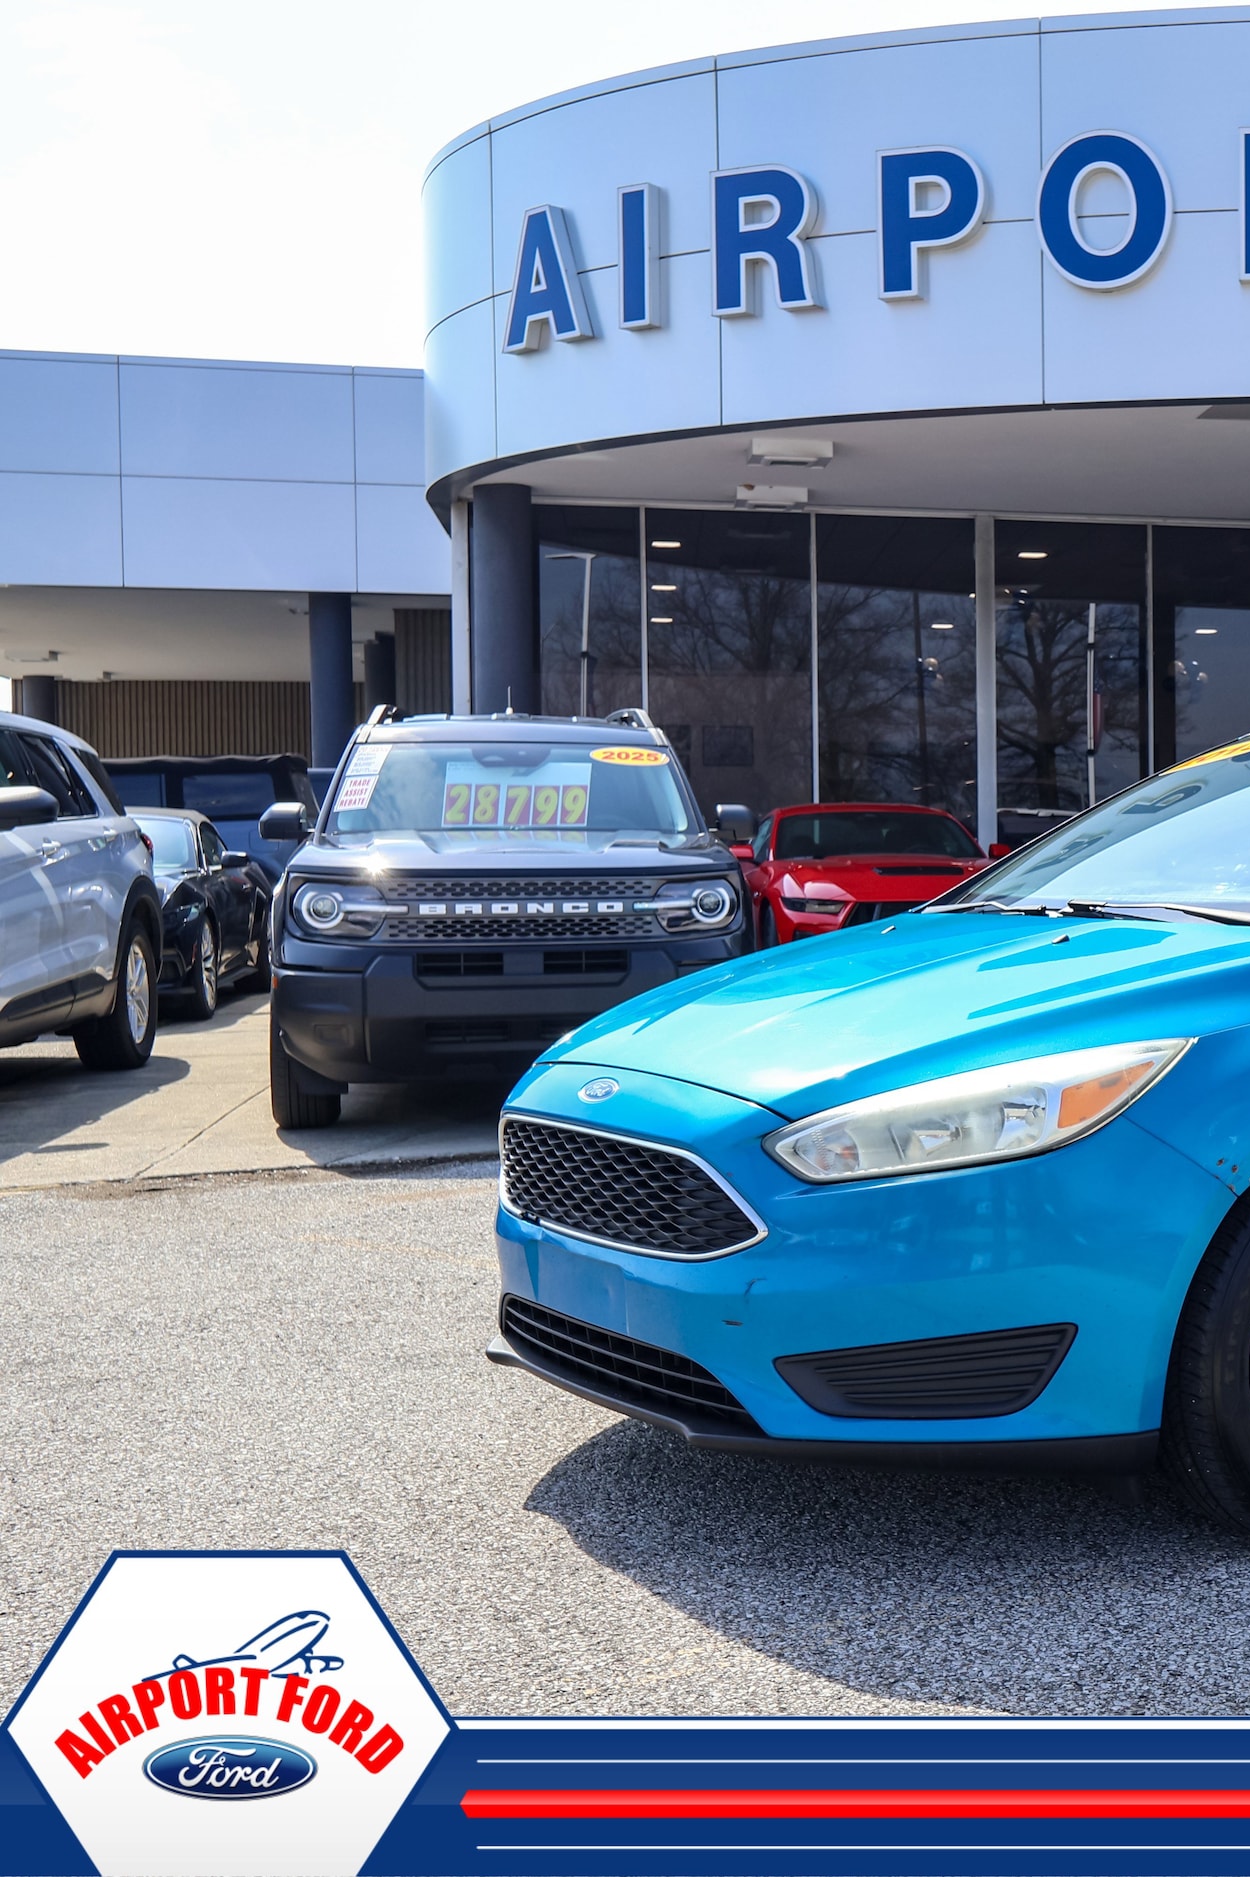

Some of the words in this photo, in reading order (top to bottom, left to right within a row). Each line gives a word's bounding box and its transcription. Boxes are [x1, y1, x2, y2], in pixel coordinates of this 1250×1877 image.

[601, 751, 659, 762] 2025
[349, 778, 371, 788] TRADE
[344, 788, 368, 798] ASSIST
[339, 798, 366, 807] REBATE
[445, 784, 587, 825] 28799
[418, 902, 624, 915] BRONCO
